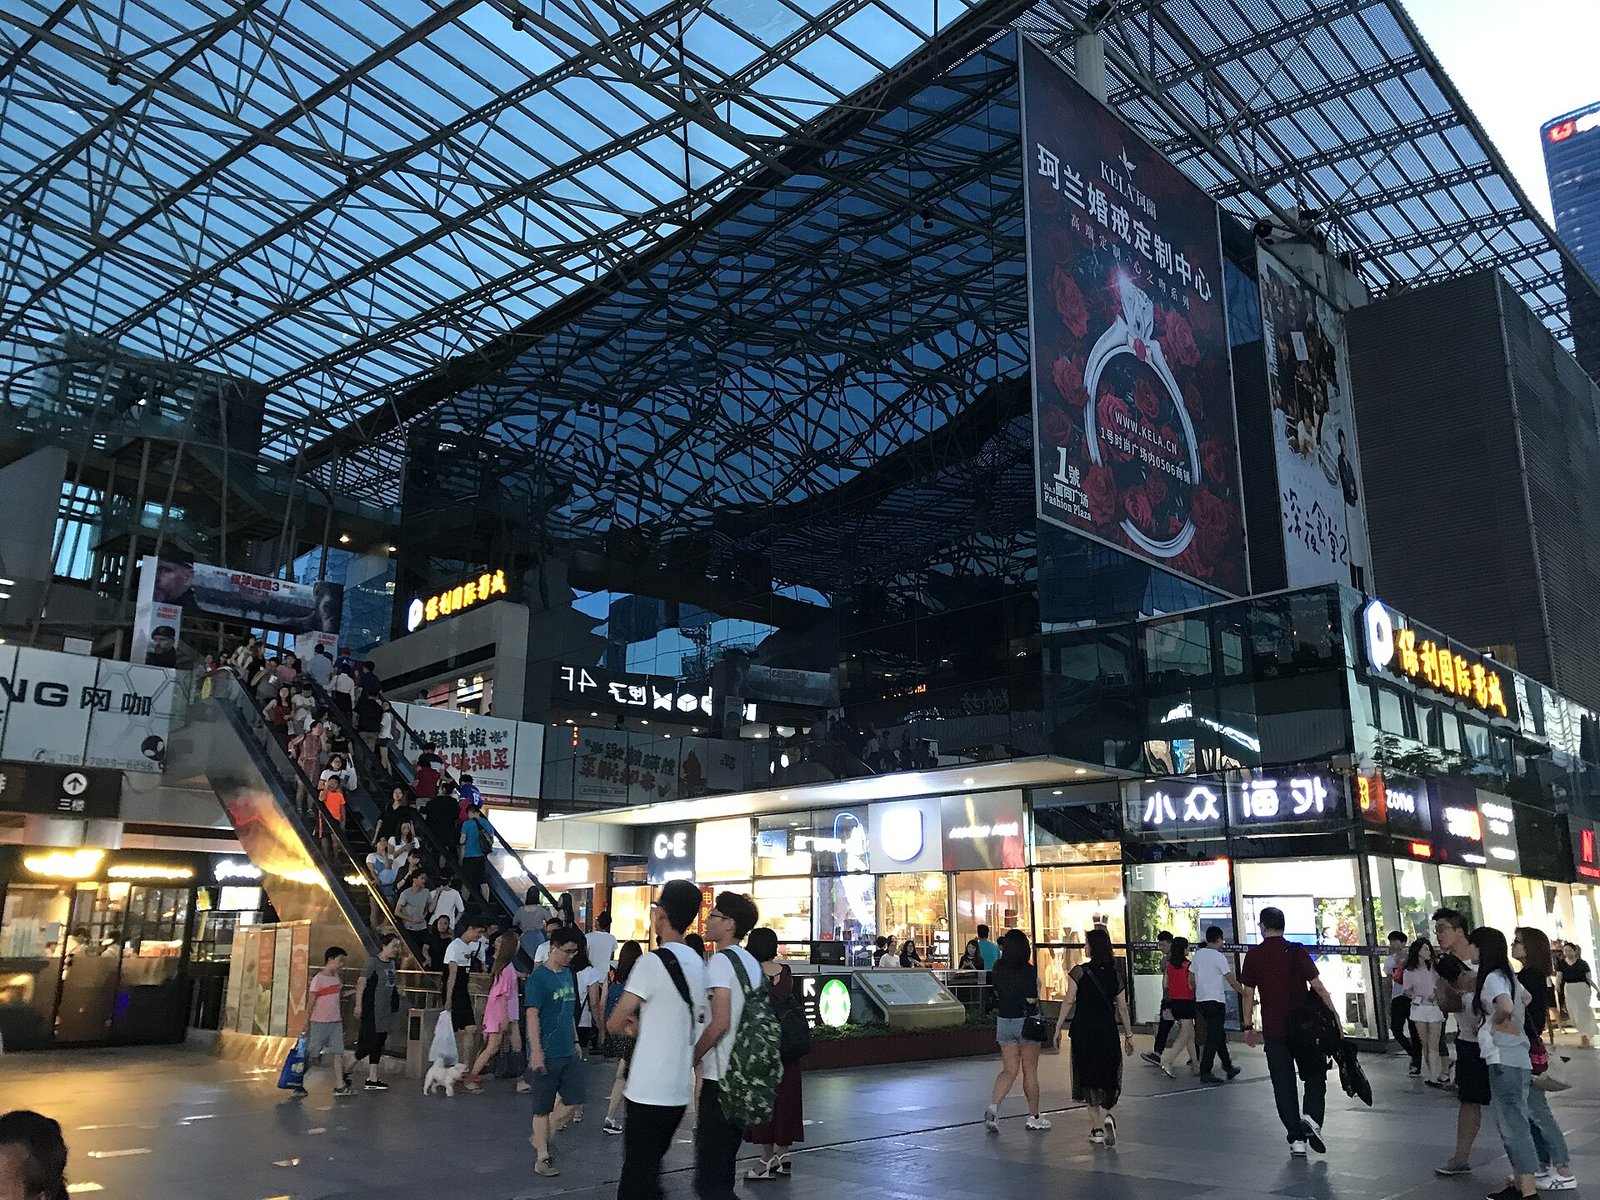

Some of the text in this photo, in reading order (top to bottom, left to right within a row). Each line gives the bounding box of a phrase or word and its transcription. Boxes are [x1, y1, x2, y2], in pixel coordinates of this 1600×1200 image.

[1100, 160, 1135, 203] KELA
[1037, 143, 1212, 302] 珂兰婚戒定制中心
[1099, 427, 1191, 485] 1号时尚广场内0506商铺
[1114, 411, 1178, 456] WWW.KELA.CN
[1043, 491, 1092, 522] Fashion Plaza
[1398, 628, 1508, 718] 保利国际影城
[79, 686, 152, 717] 网咖
[57, 798, 86, 812] 三楼
[1143, 776, 1328, 825] 小众海外
